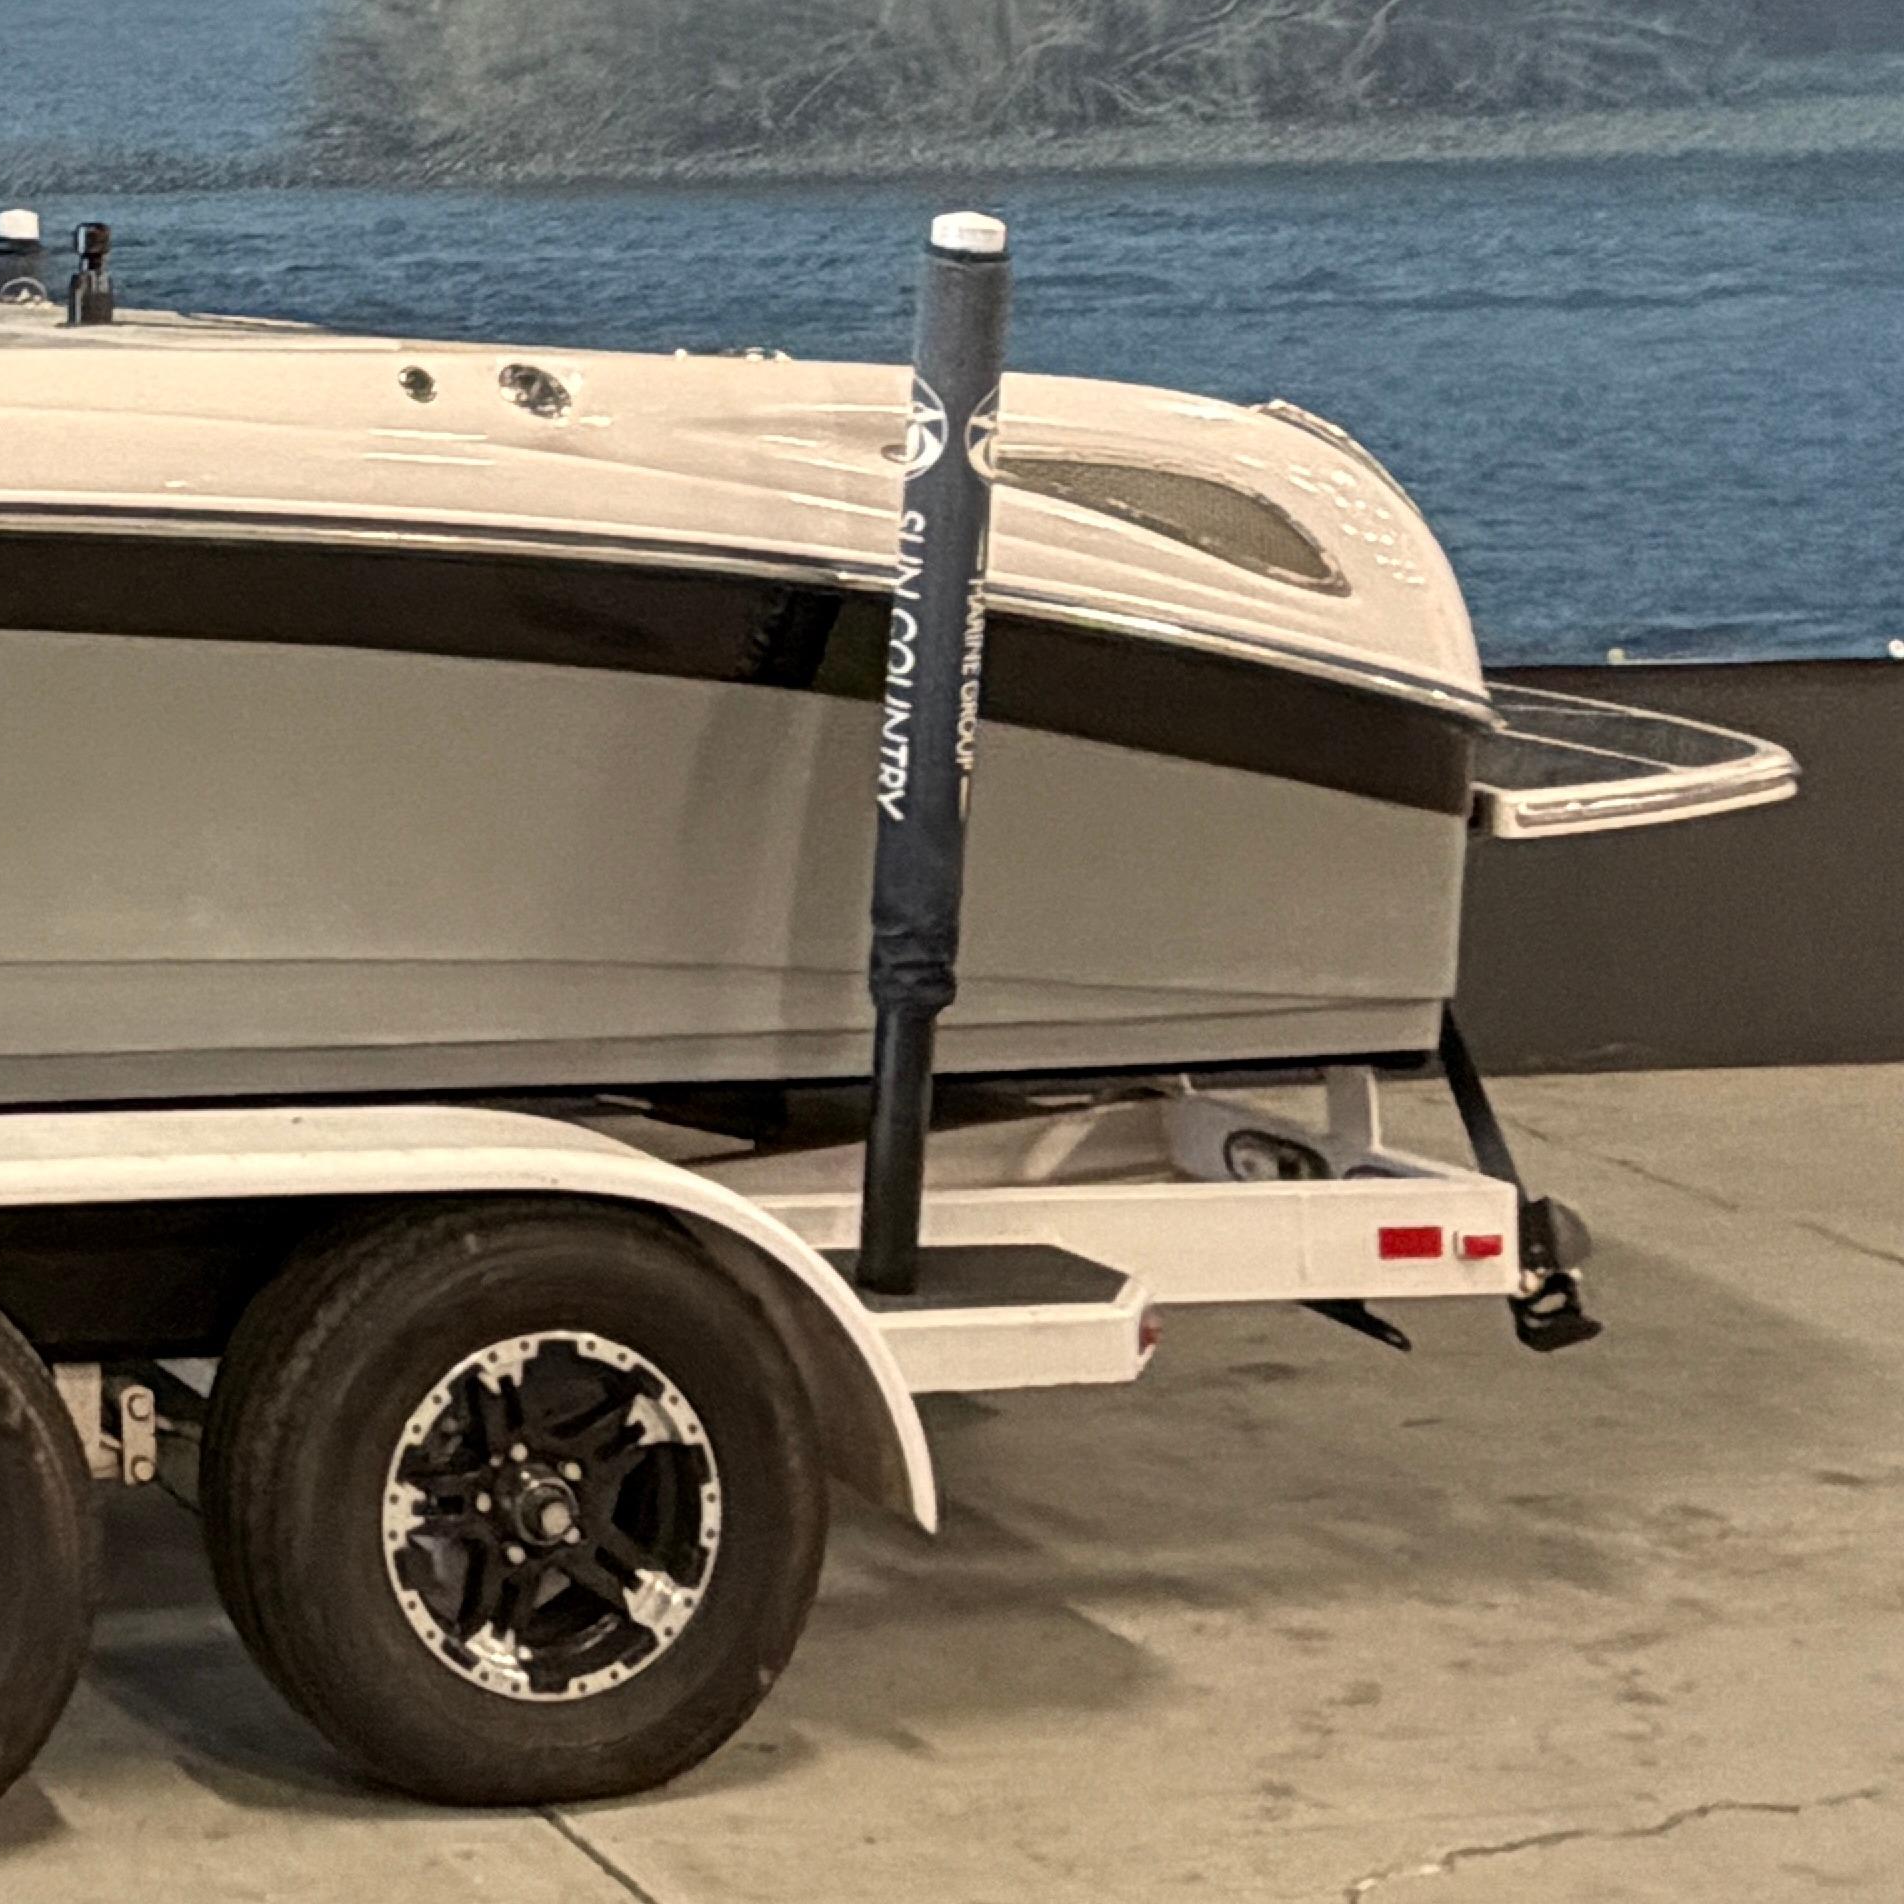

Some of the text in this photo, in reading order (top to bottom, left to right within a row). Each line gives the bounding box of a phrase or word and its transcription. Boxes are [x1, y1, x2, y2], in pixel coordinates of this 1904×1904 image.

[877, 510, 926, 822] SUN COUNTRY
[954, 679, 981, 770] GROUP
